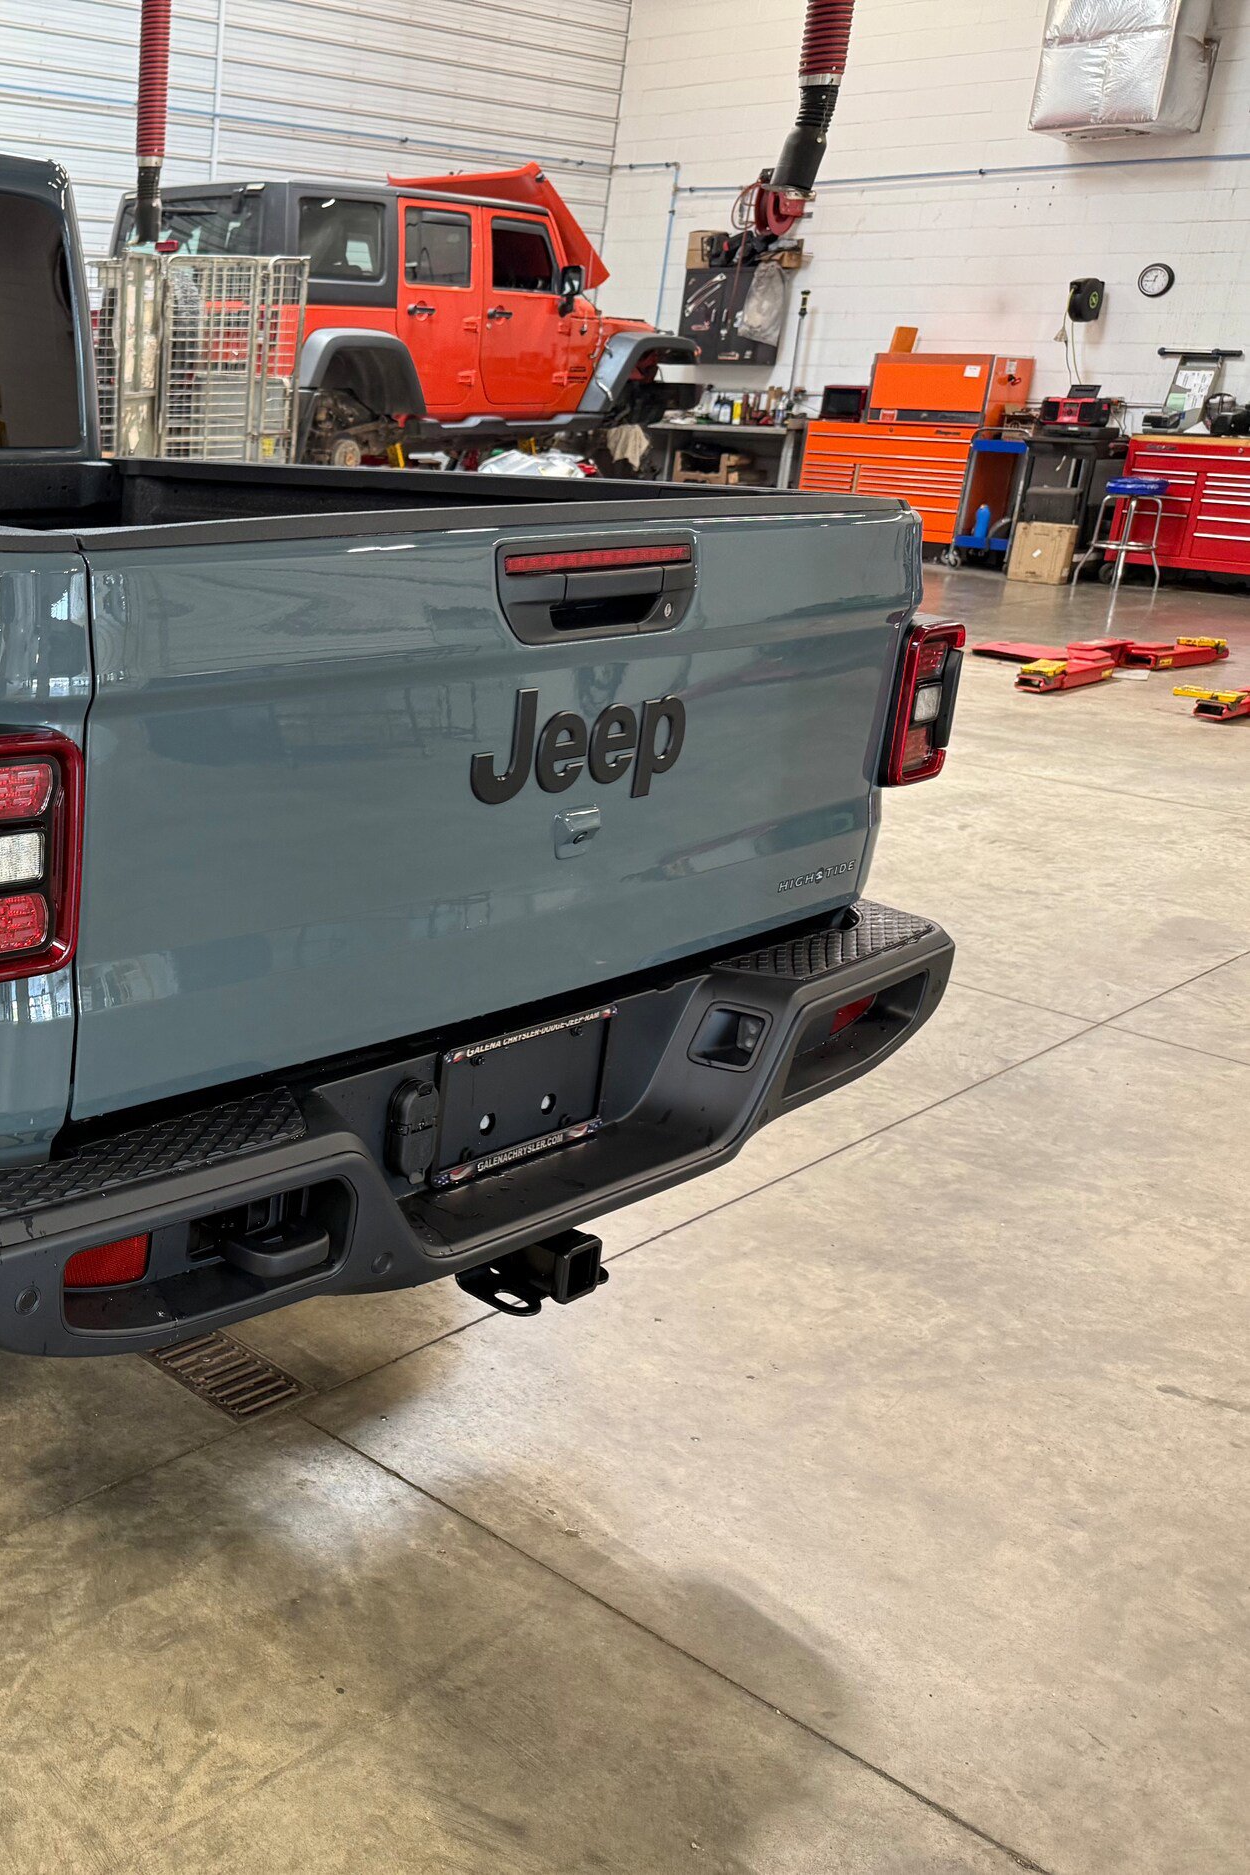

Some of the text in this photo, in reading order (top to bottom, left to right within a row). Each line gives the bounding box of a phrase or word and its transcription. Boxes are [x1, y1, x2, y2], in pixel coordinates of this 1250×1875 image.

[470, 687, 686, 805] Jeep
[778, 859, 856, 893] HIGH TIDE
[466, 1040, 502, 1058] GALENA
[477, 1133, 564, 1172] GALENACHRYSLER.COM
